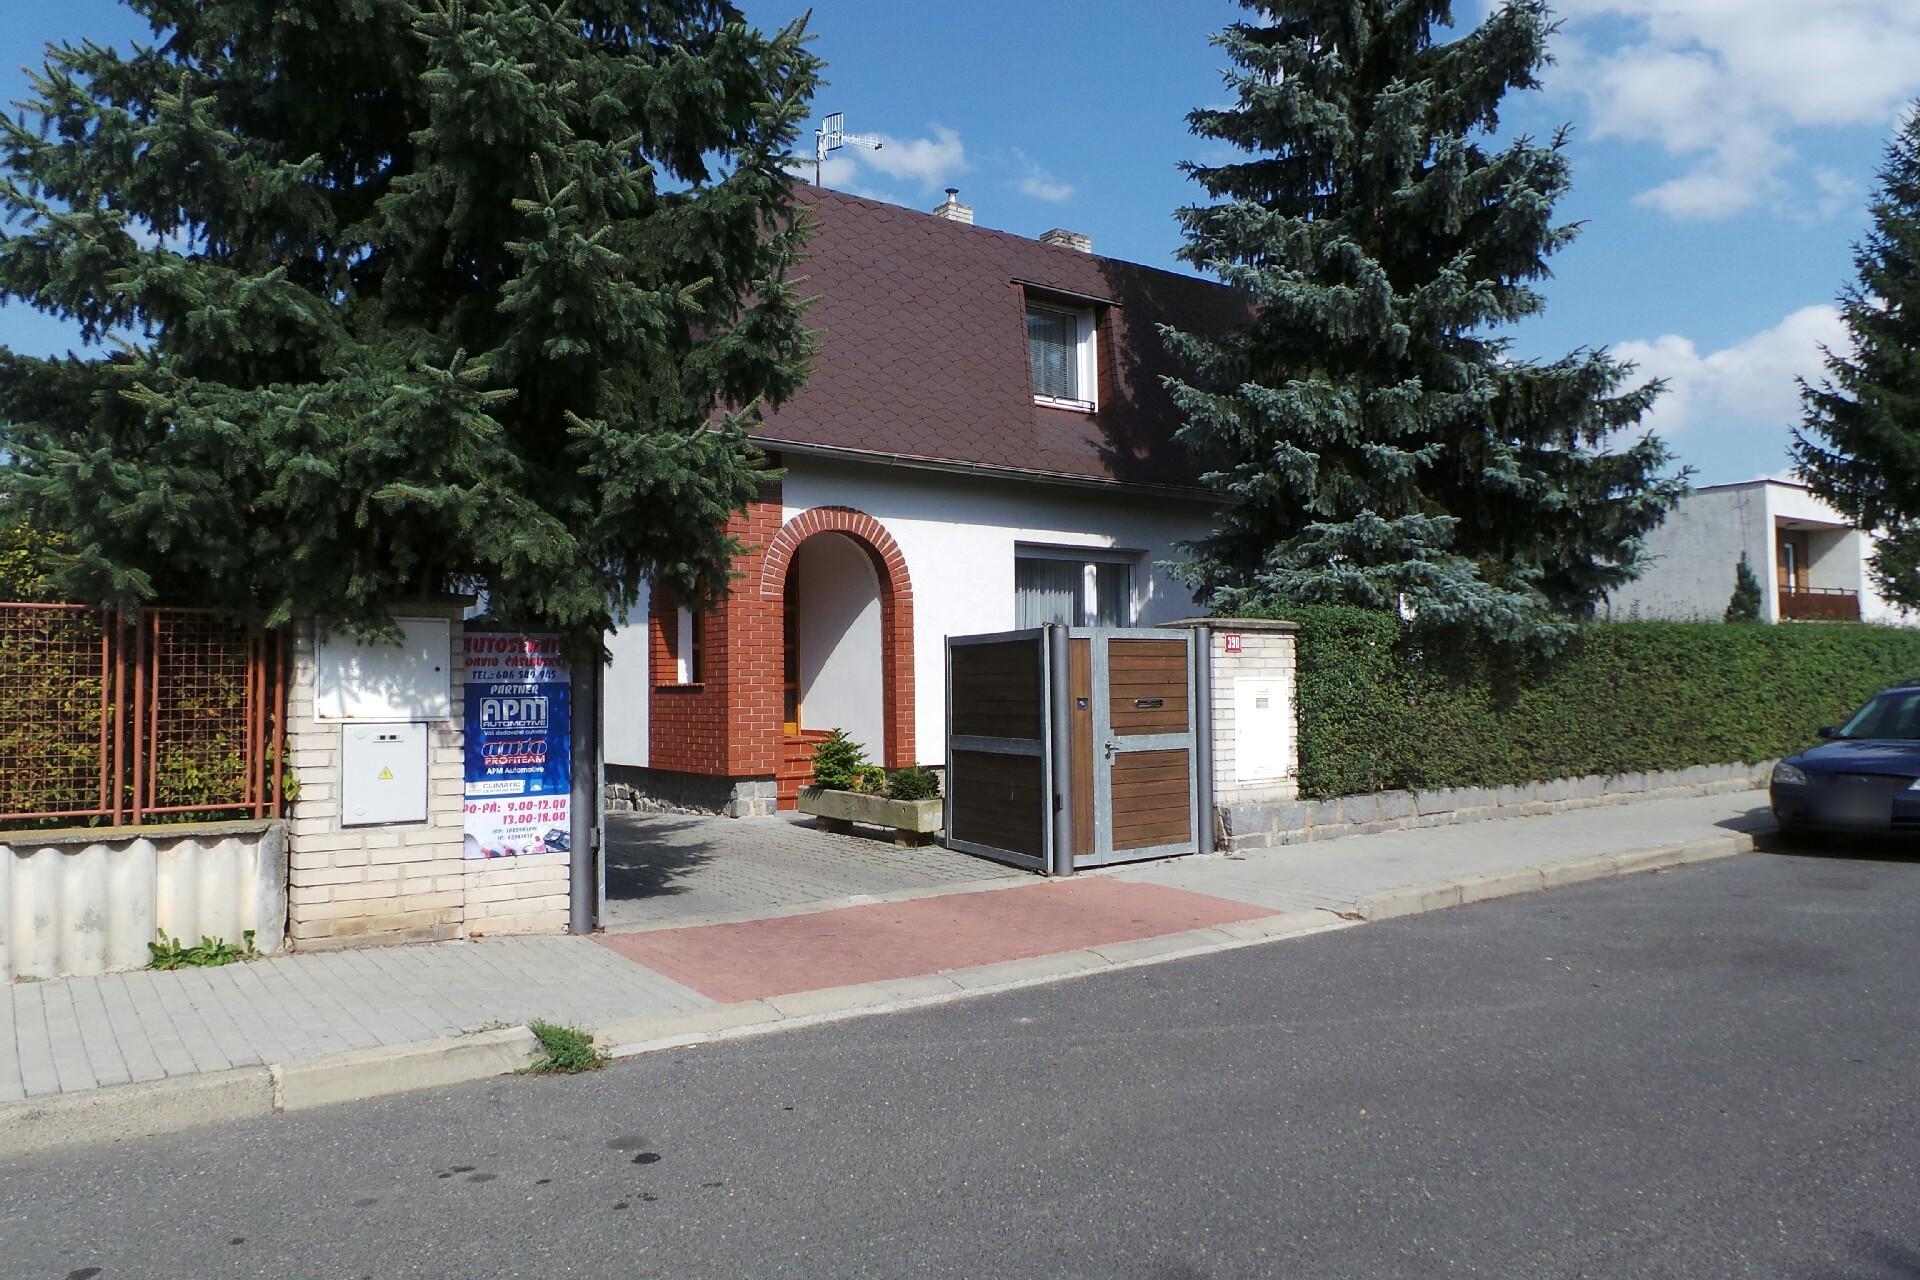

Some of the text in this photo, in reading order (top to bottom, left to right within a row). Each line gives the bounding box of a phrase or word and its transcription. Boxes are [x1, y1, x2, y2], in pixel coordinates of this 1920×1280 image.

[1228, 637, 1239, 648] 390
[473, 671, 494, 680] TEL.:
[496, 671, 514, 680] 606
[490, 684, 539, 695] PARTNER
[483, 699, 546, 721] APM
[483, 720, 546, 728] AUTOMOTIVE
[485, 755, 546, 766] PROFITEAM
[486, 766, 545, 775] APM Automotive
[503, 812, 566, 824] 13.00-18.00
